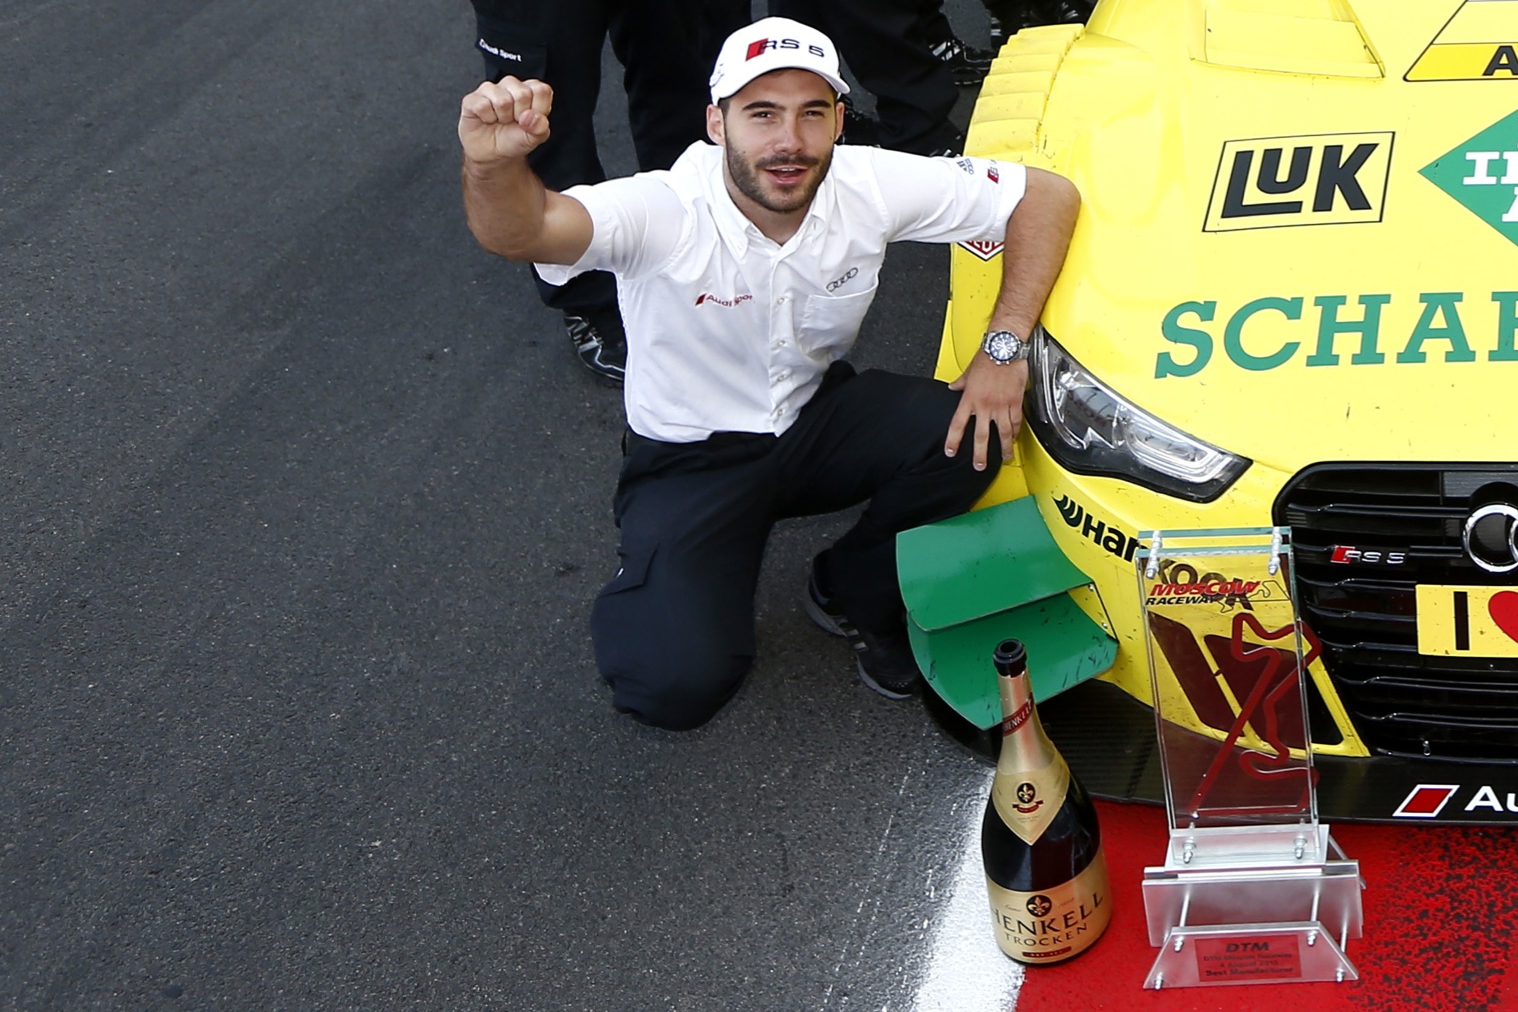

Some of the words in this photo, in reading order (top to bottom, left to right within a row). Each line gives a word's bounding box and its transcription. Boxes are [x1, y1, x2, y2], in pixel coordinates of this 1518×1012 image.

[706, 295, 732, 307] Audi
[1386, 552, 1406, 564] 5
[1150, 580, 1261, 596] MOSCOW
[1145, 595, 1217, 605] RACEWAY
[1453, 591, 1470, 651] I
[1004, 923, 1088, 947] TROCKEN
[1226, 942, 1269, 953] DTM
